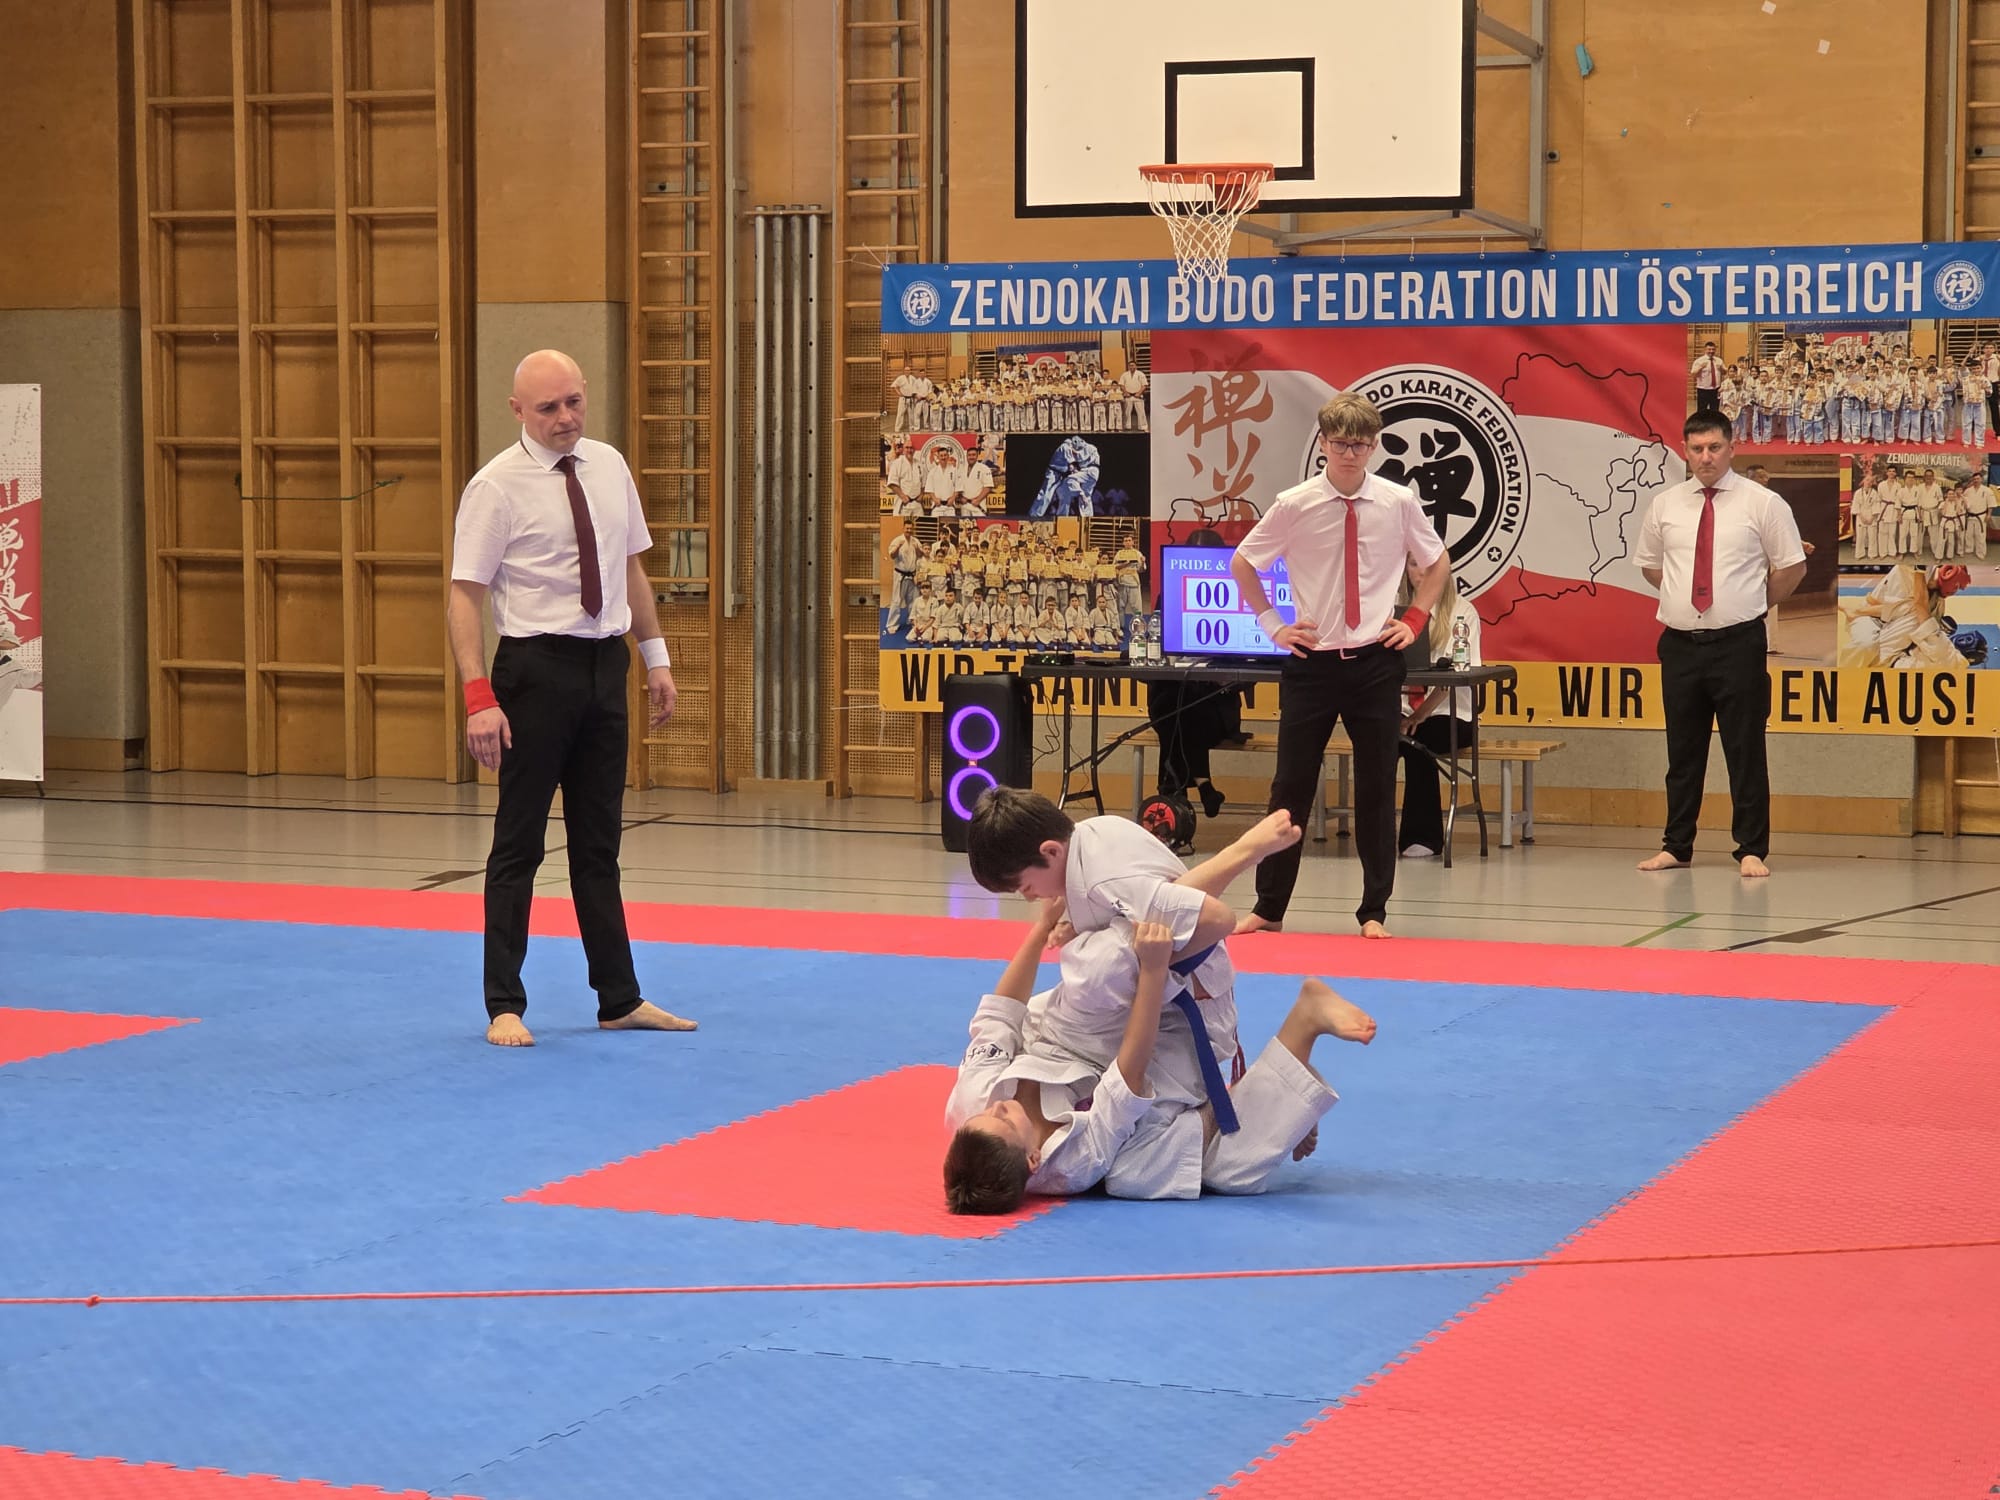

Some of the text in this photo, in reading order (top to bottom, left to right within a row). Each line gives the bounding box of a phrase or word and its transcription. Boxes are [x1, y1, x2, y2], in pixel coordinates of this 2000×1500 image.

[950, 277, 1149, 326] ZENDOKAI
[1168, 274, 1275, 323] BUDO
[1293, 269, 1556, 321] FEDERATION
[1577, 268, 1618, 318] IN
[1638, 258, 1923, 317] ÖSTERREICH
[1366, 379, 1522, 534] DO KARATE FEDERATION
[1887, 453, 1960, 466] ZENDOKAI KARATE
[1170, 559, 1226, 571] PRIDE &
[1196, 581, 1229, 608] 00
[1196, 619, 1229, 645] 00
[1558, 666, 1643, 718] WIR
[1862, 671, 1975, 725] AUS!
